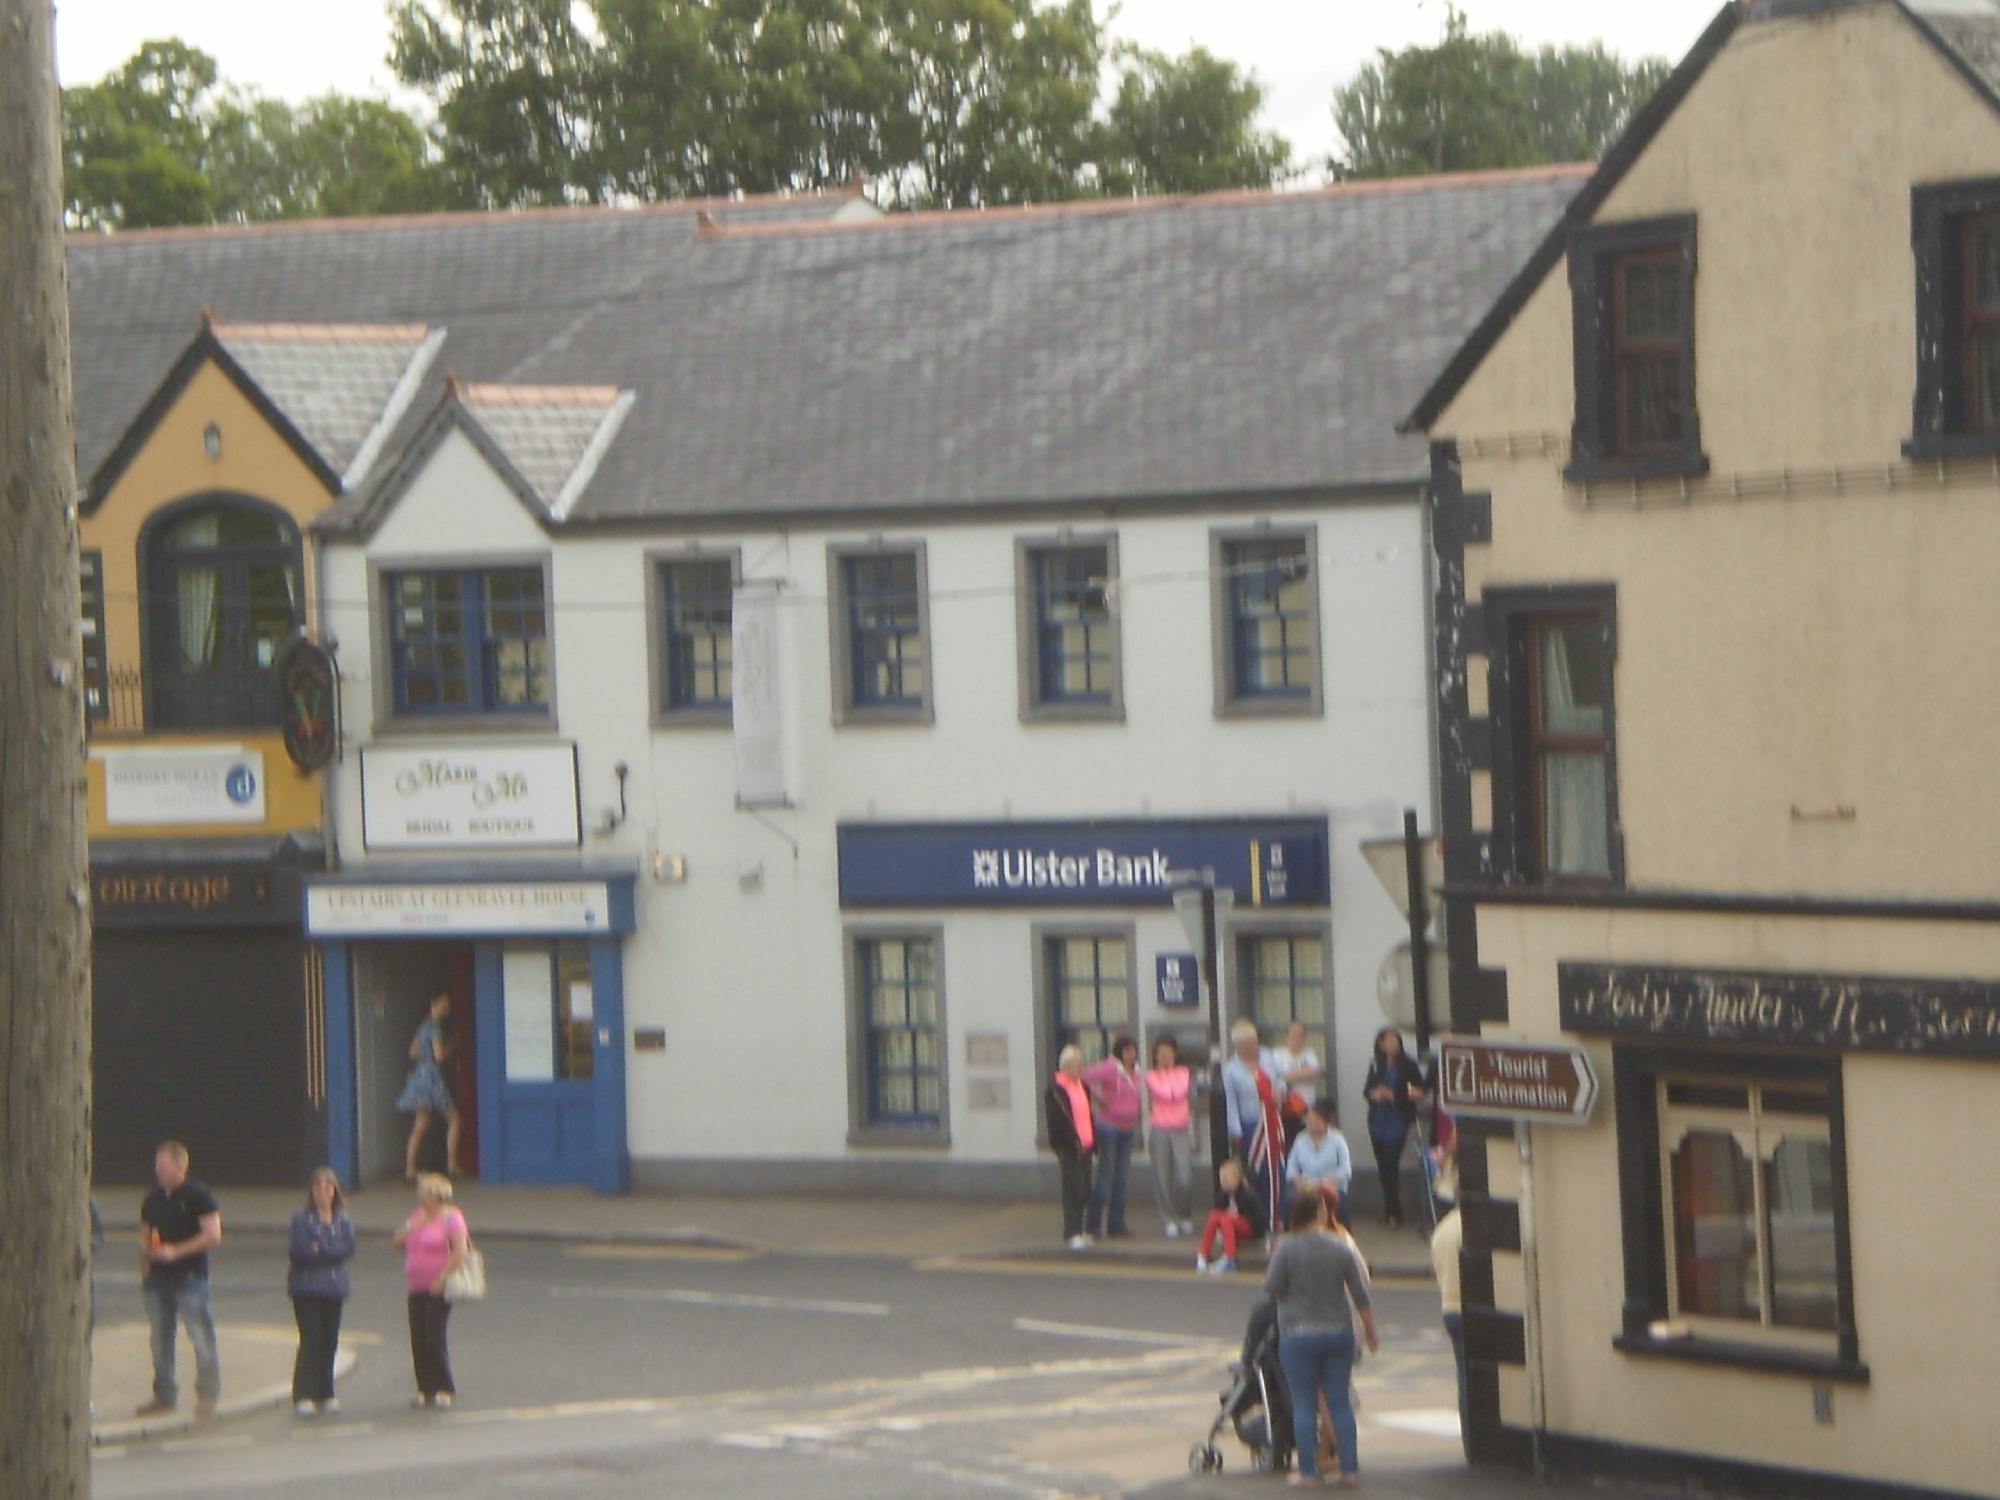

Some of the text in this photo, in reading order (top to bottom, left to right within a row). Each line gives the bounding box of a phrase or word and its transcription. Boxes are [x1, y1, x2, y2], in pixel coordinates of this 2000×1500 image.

[1003, 848, 1169, 888] Ulster Bank
[326, 888, 402, 909] UPSTAIRS
[430, 888, 528, 909] GLENRAVEL
[533, 888, 587, 909] HOUSE
[1493, 1051, 1547, 1081] Tourist
